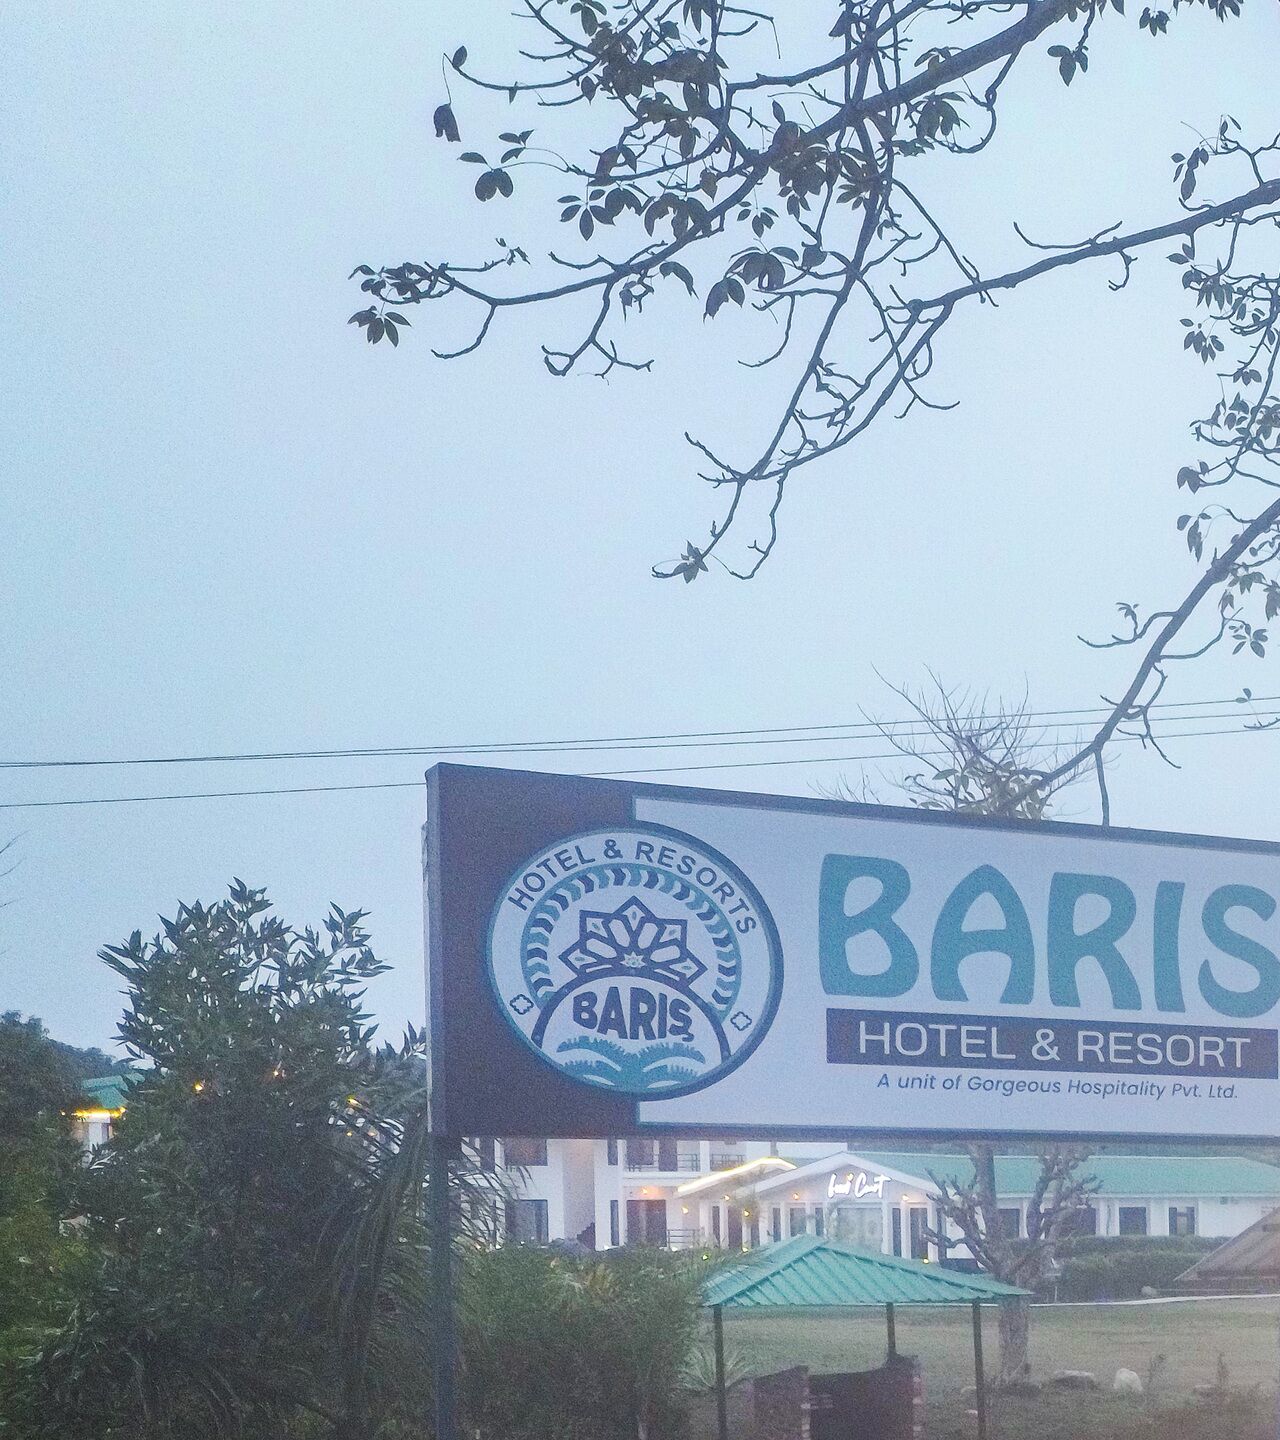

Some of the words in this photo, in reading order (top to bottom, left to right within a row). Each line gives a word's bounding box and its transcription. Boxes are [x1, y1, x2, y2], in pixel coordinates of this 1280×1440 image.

[507, 845, 596, 911] HOTEL
[603, 839, 624, 859] &
[634, 841, 757, 934] RESORTS
[858, 1021, 1016, 1060] HOTEL
[1031, 1028, 1061, 1062] &
[1076, 1030, 1251, 1069] RESORT
[877, 1073, 890, 1088] A
[897, 1073, 937, 1090] unit
[942, 1074, 962, 1090] of
[967, 1075, 1062, 1097] Gorgeous
[1067, 1079, 1167, 1101] Hospitality
[1171, 1083, 1202, 1098] Pvt.
[1208, 1084, 1238, 1099] Ltd.
